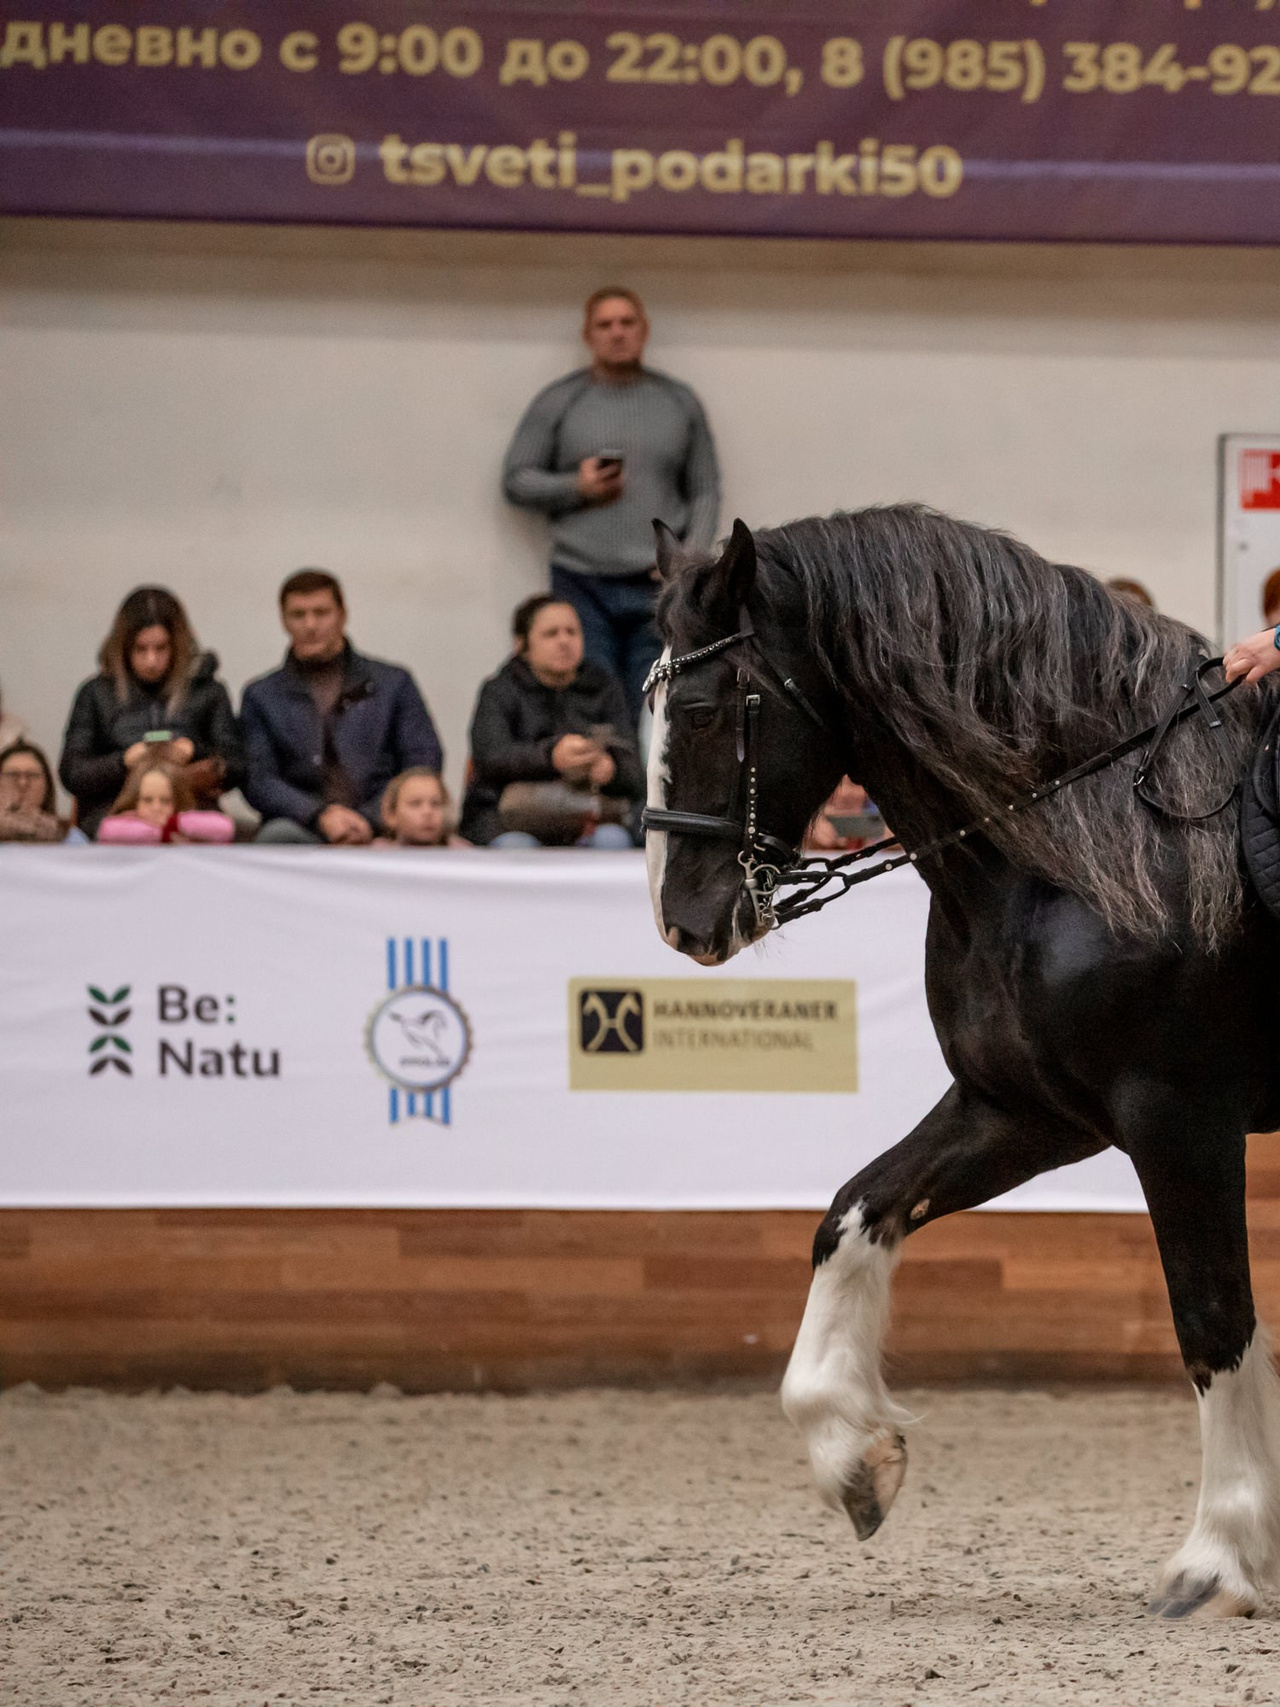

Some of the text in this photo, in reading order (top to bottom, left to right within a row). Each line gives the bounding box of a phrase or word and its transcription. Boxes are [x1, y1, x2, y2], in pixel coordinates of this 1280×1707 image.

[0, 20, 263, 71] дневно
[279, 30, 319, 73] с
[336, 22, 484, 78] 9:00
[499, 38, 590, 86] до
[605, 31, 803, 97] 22:00,
[820, 36, 866, 88] 8
[882, 35, 1046, 104] (985)
[378, 130, 964, 202] tsveti_podarki50
[157, 984, 236, 1024] Be:
[653, 1000, 839, 1021] HANNOVERANER
[157, 1038, 281, 1078] Natu
[653, 1028, 814, 1051] INTERNATIONAL
